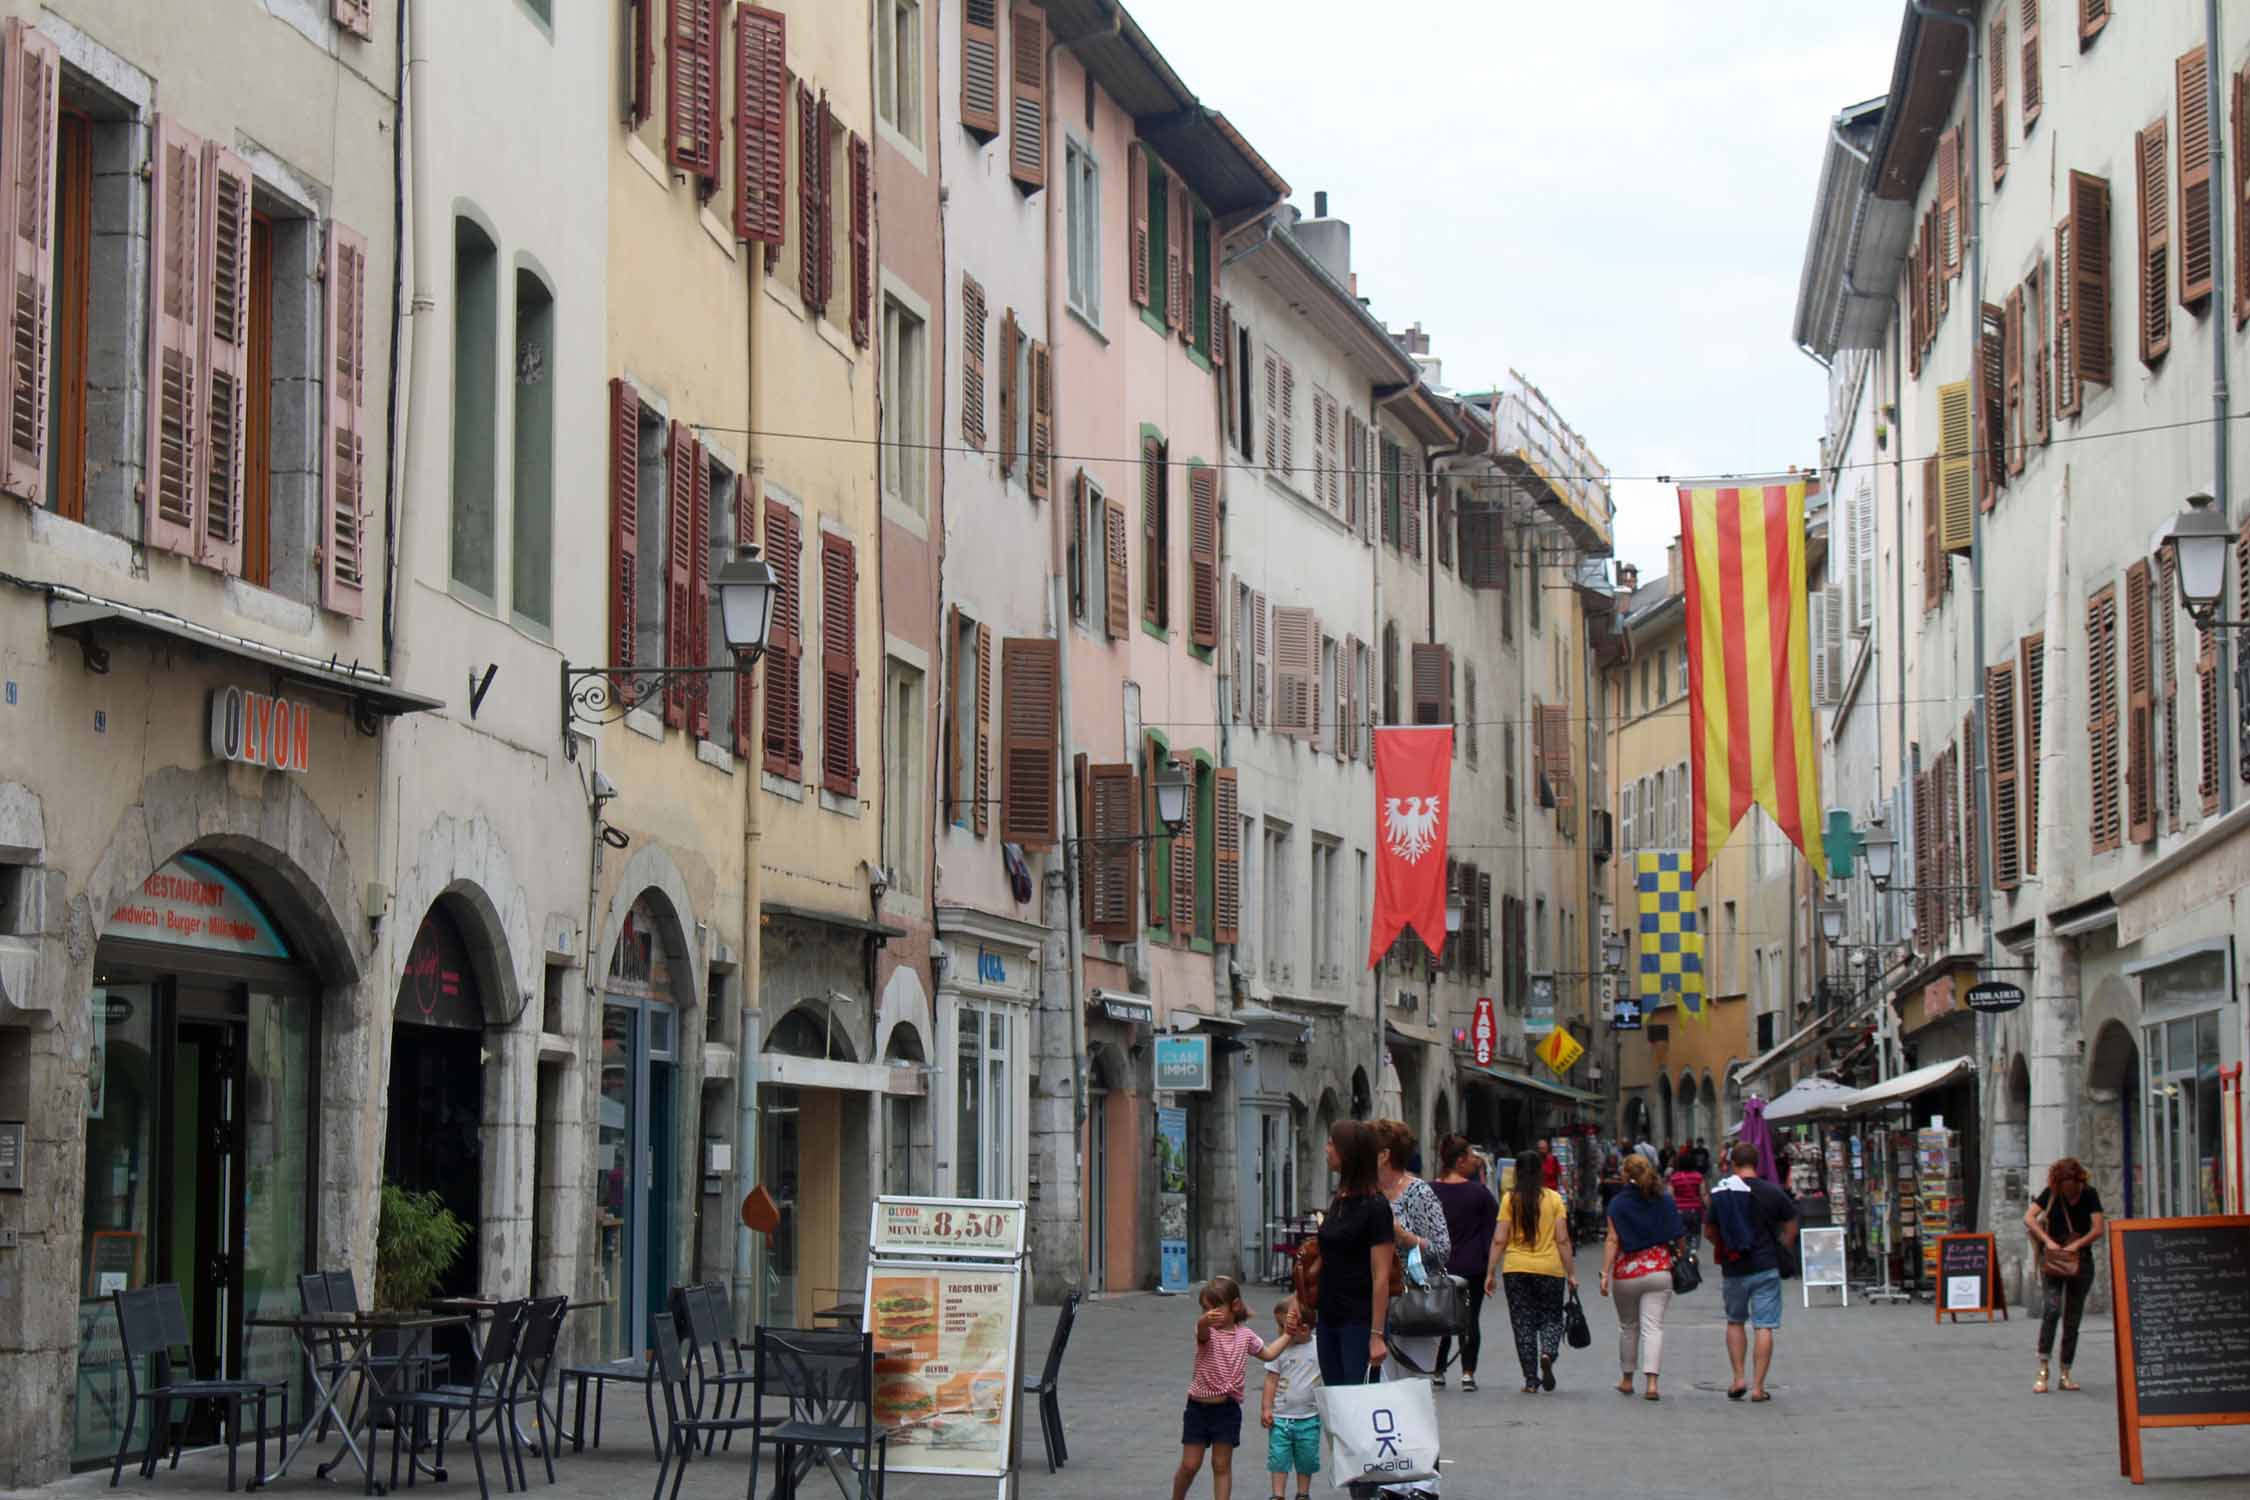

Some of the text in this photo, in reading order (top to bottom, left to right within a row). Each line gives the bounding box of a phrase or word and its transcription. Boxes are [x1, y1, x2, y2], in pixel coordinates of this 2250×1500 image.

[224, 686, 310, 772] OLYON
[143, 874, 224, 907] RESTAURANT
[167, 909, 201, 936] Burger
[1476, 1001, 1491, 1063] TABAC
[1163, 1064, 1198, 1076] IMMO
[888, 1207, 919, 1217] OLYON
[888, 1225, 918, 1236] MENU
[948, 1284, 973, 1293] TACOS
